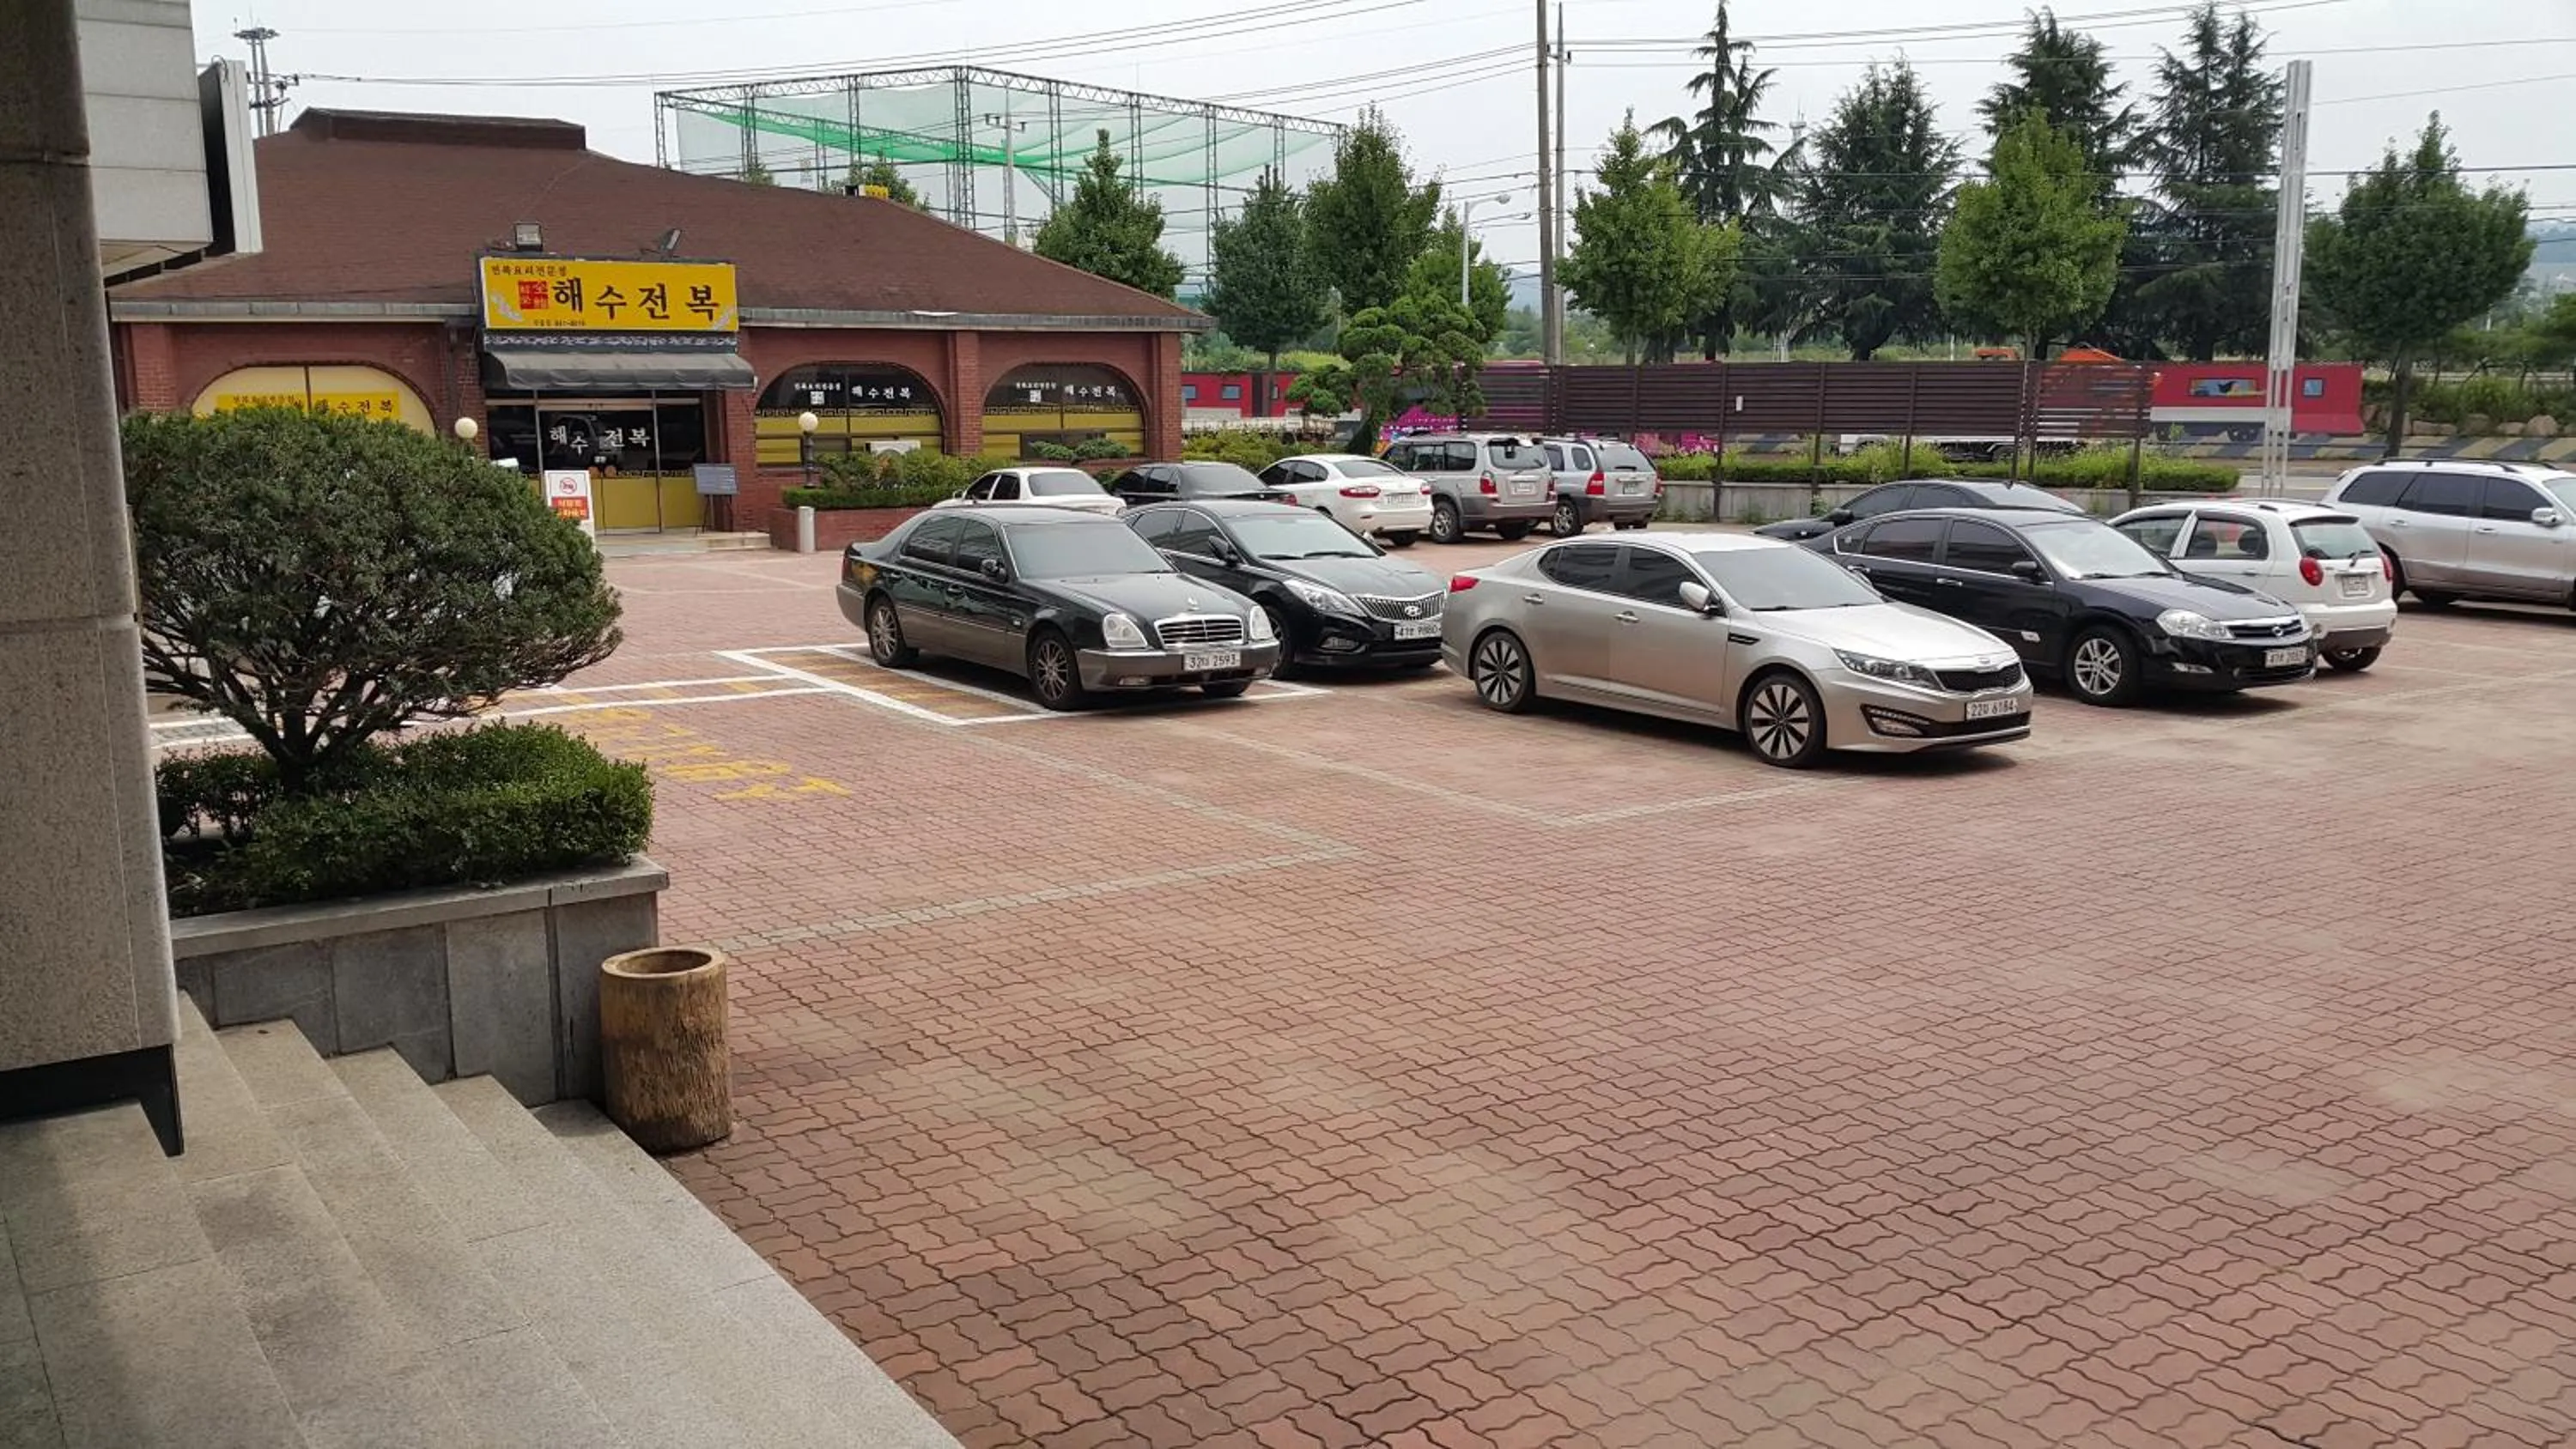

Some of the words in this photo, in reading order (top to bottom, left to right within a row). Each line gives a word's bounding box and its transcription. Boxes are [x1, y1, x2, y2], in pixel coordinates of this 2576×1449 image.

[552, 276, 720, 322] 해수전복
[550, 425, 651, 456] 해수전복
[1213, 654, 1236, 667] 2593
